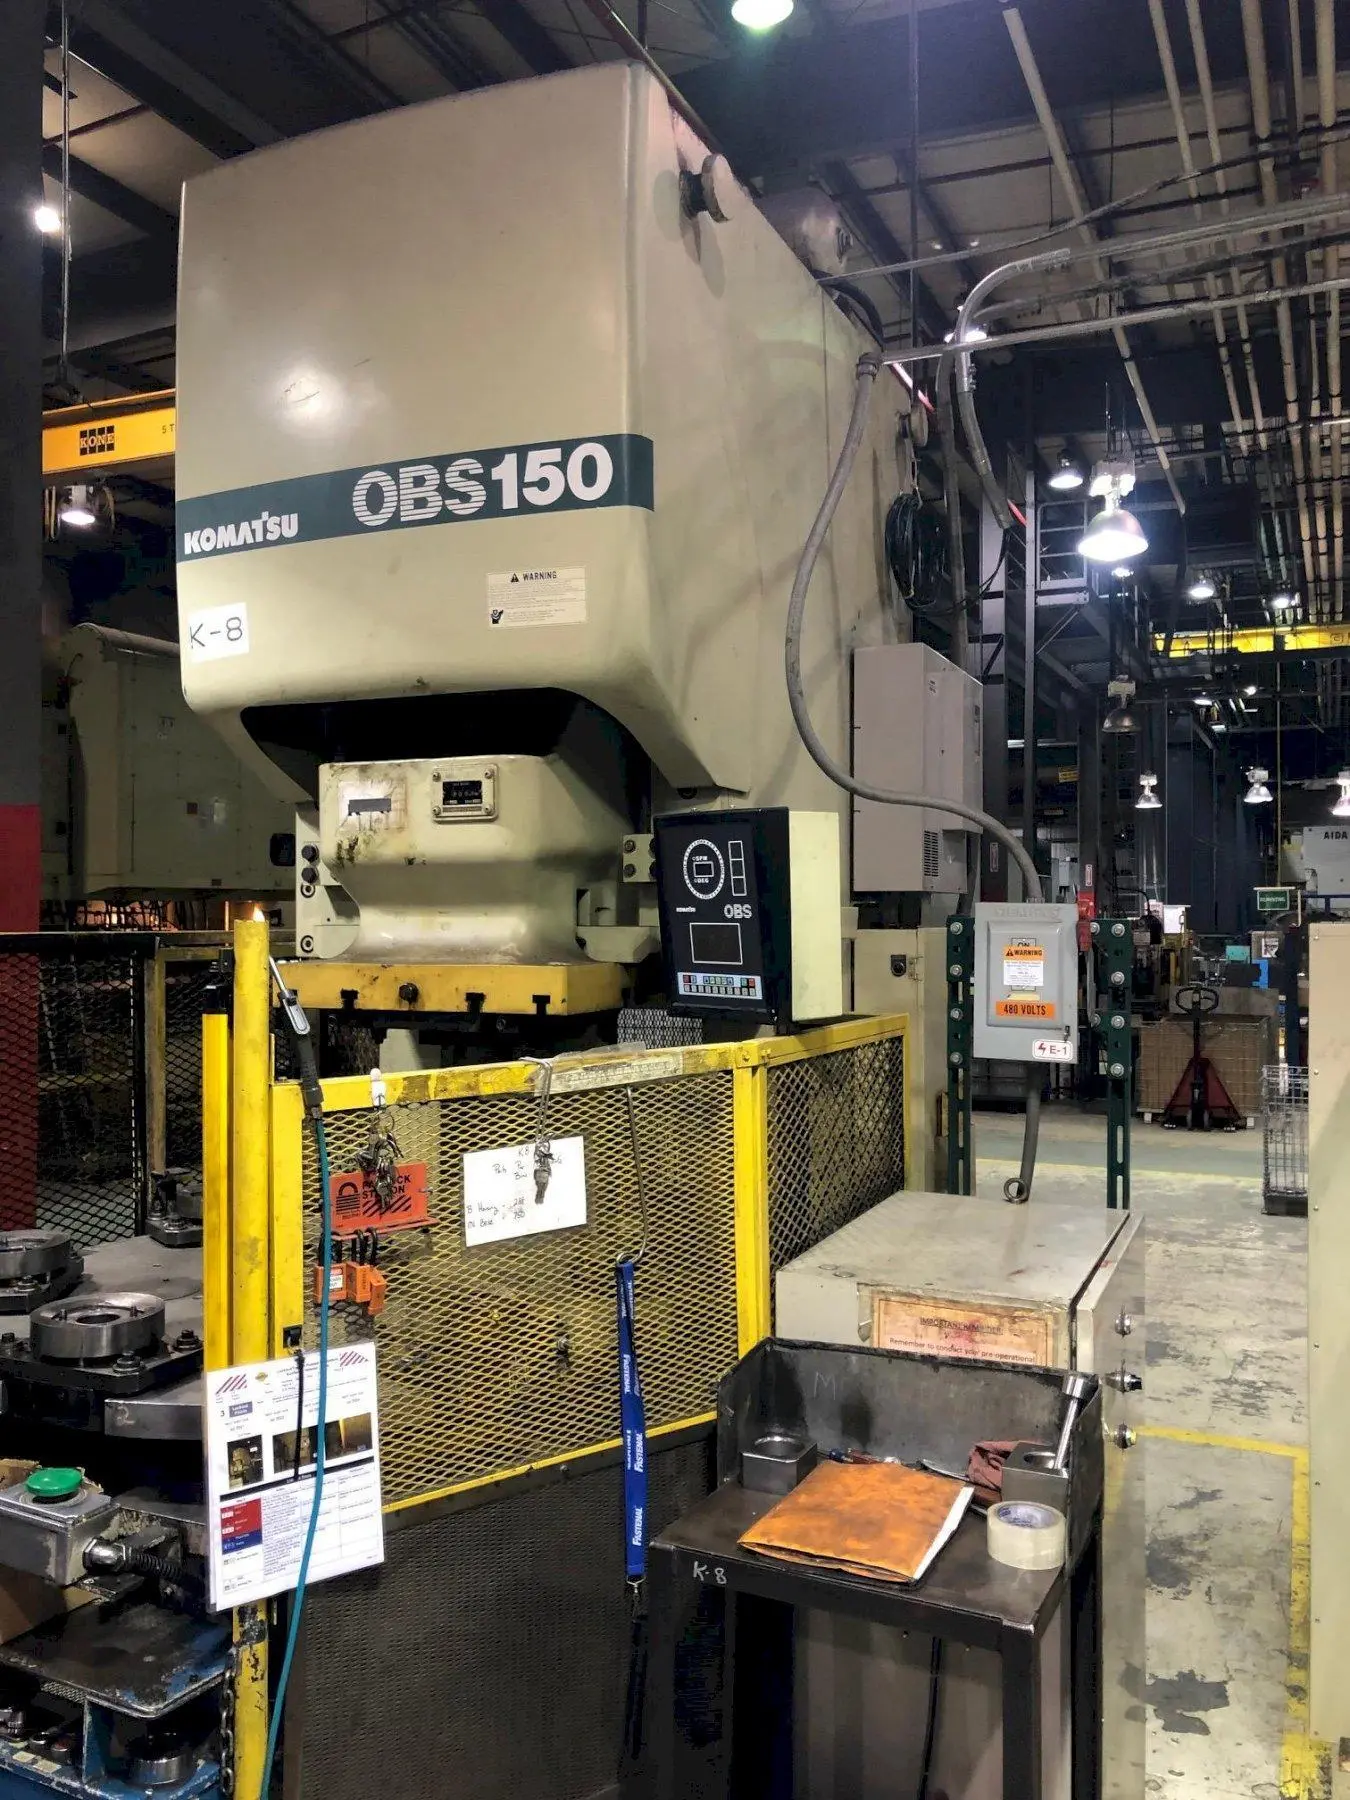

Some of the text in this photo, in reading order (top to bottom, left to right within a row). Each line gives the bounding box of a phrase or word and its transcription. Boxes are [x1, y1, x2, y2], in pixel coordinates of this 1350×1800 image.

[80, 433, 115, 448] KONE
[184, 511, 299, 554] KOMATSU
[522, 571, 557, 581] WARNING
[189, 616, 244, 649] K-8
[1323, 831, 1348, 840] AIDA
[723, 904, 752, 919] OBS
[1004, 1004, 1046, 1016] 480 VOLTS
[890, 1337, 925, 1348] Remember
[693, 1561, 727, 1585] K-8
